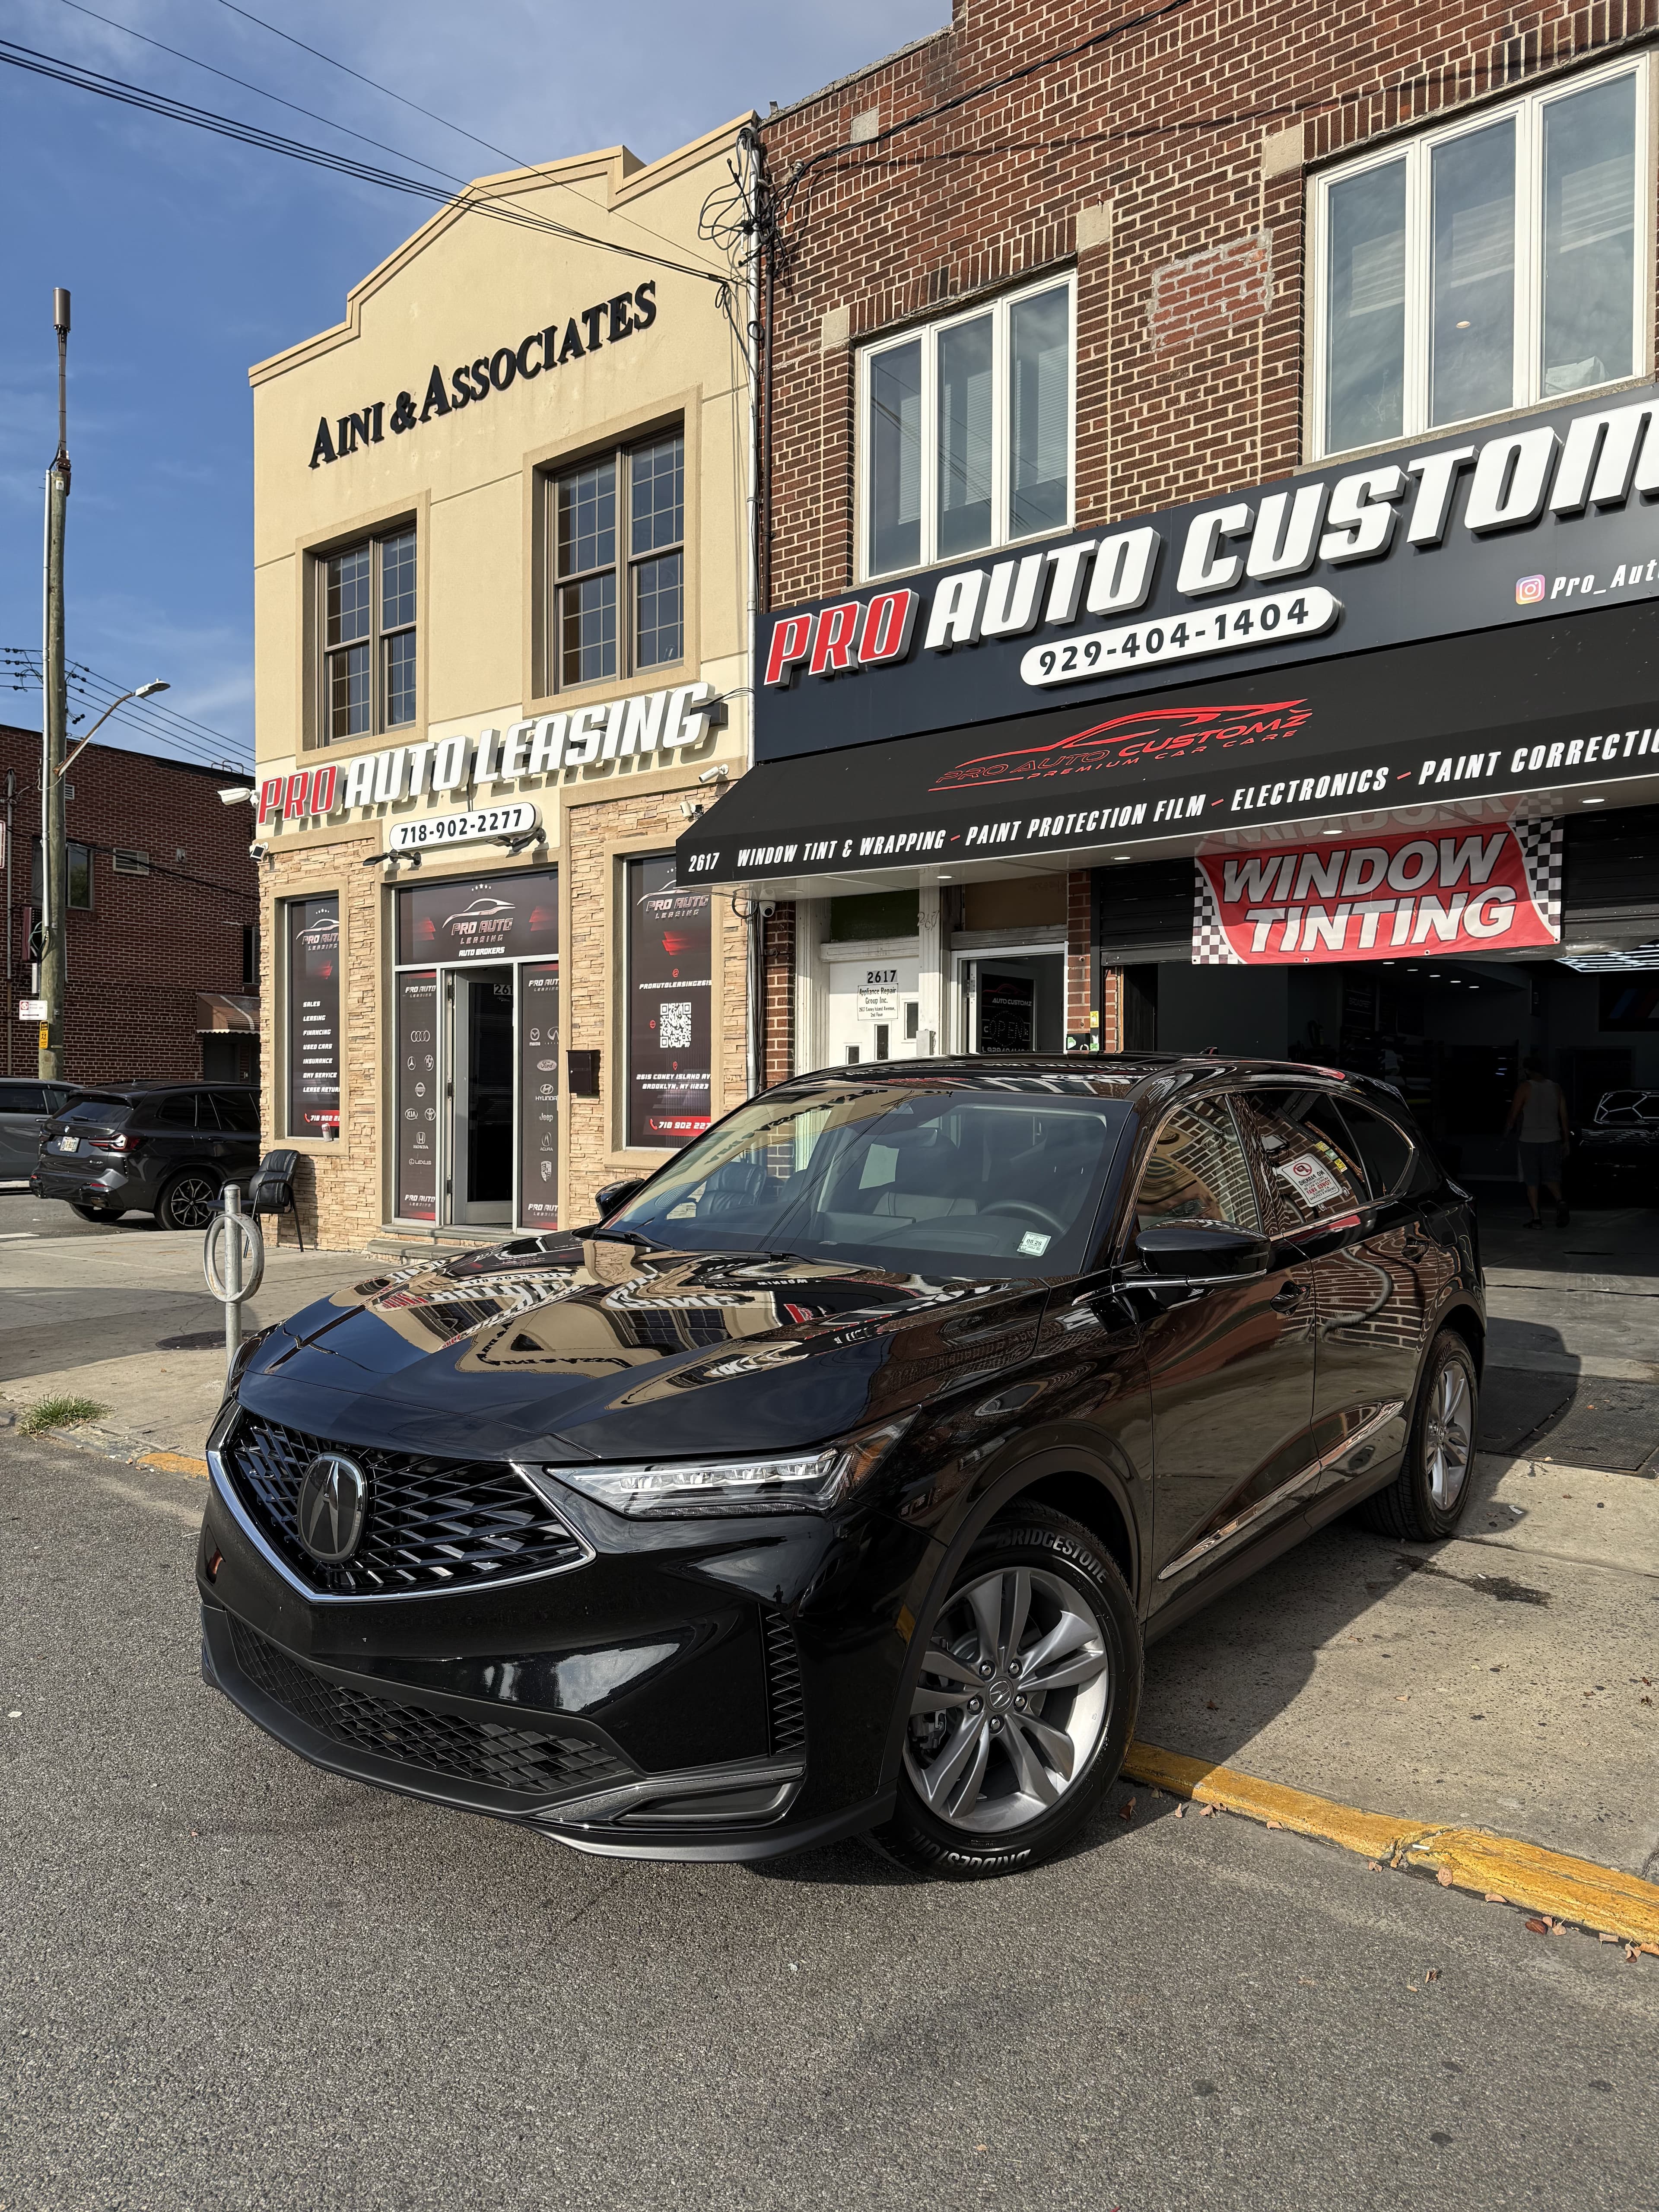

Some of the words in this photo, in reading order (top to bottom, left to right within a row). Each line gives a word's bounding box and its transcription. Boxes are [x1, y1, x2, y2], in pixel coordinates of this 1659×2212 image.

[308, 401, 385, 469] AINI
[390, 391, 417, 432] &
[417, 280, 656, 423] ASSOCIATES
[1550, 559, 1659, 600] Pro_Aut
[763, 588, 918, 688] PRO
[924, 526, 1161, 652] AUTO
[1039, 597, 1309, 676] 929-404-1404
[258, 764, 344, 825] PRO
[345, 735, 473, 808] AUTO
[474, 682, 715, 784] LEASING
[935, 764, 1008, 783] PRO
[1010, 750, 1110, 773] AUTO
[1027, 757, 1139, 779] PREMIUM
[1154, 746, 1207, 760] CAR
[1223, 730, 1298, 748] CARE
[401, 809, 522, 844] 718-902-2277
[687, 852, 720, 872] 2617
[737, 845, 798, 868] WINDOW
[803, 840, 838, 862] TINT
[842, 839, 852, 858] &
[859, 830, 946, 856] WRAPPING
[965, 820, 1021, 846] PAINT
[1027, 803, 1147, 839] PROTECTION
[1153, 794, 1206, 822] FILM
[1231, 767, 1389, 811] ELECTRONICS
[1418, 751, 1501, 785] PAINT
[1222, 833, 1509, 904] WINDOW
[646, 899, 673, 912] PRO
[674, 895, 709, 909] AUTO
[655, 909, 699, 919] LEASING
[1245, 885, 1517, 953] TINTING
[302, 934, 320, 945] PRO
[321, 933, 339, 943] AUT
[451, 922, 477, 936] PRO
[478, 918, 513, 934] AUTO
[460, 934, 503, 944] LEASING
[476, 947, 505, 955] BROKERS
[495, 985, 512, 994] 261
[859, 988, 879, 996] Appliance
[881, 987, 896, 995] Repair
[868, 970, 896, 983] 2617
[539, 1113, 553, 1122] Jeep
[996, 1528, 1109, 1583] BRIDGESTONE
